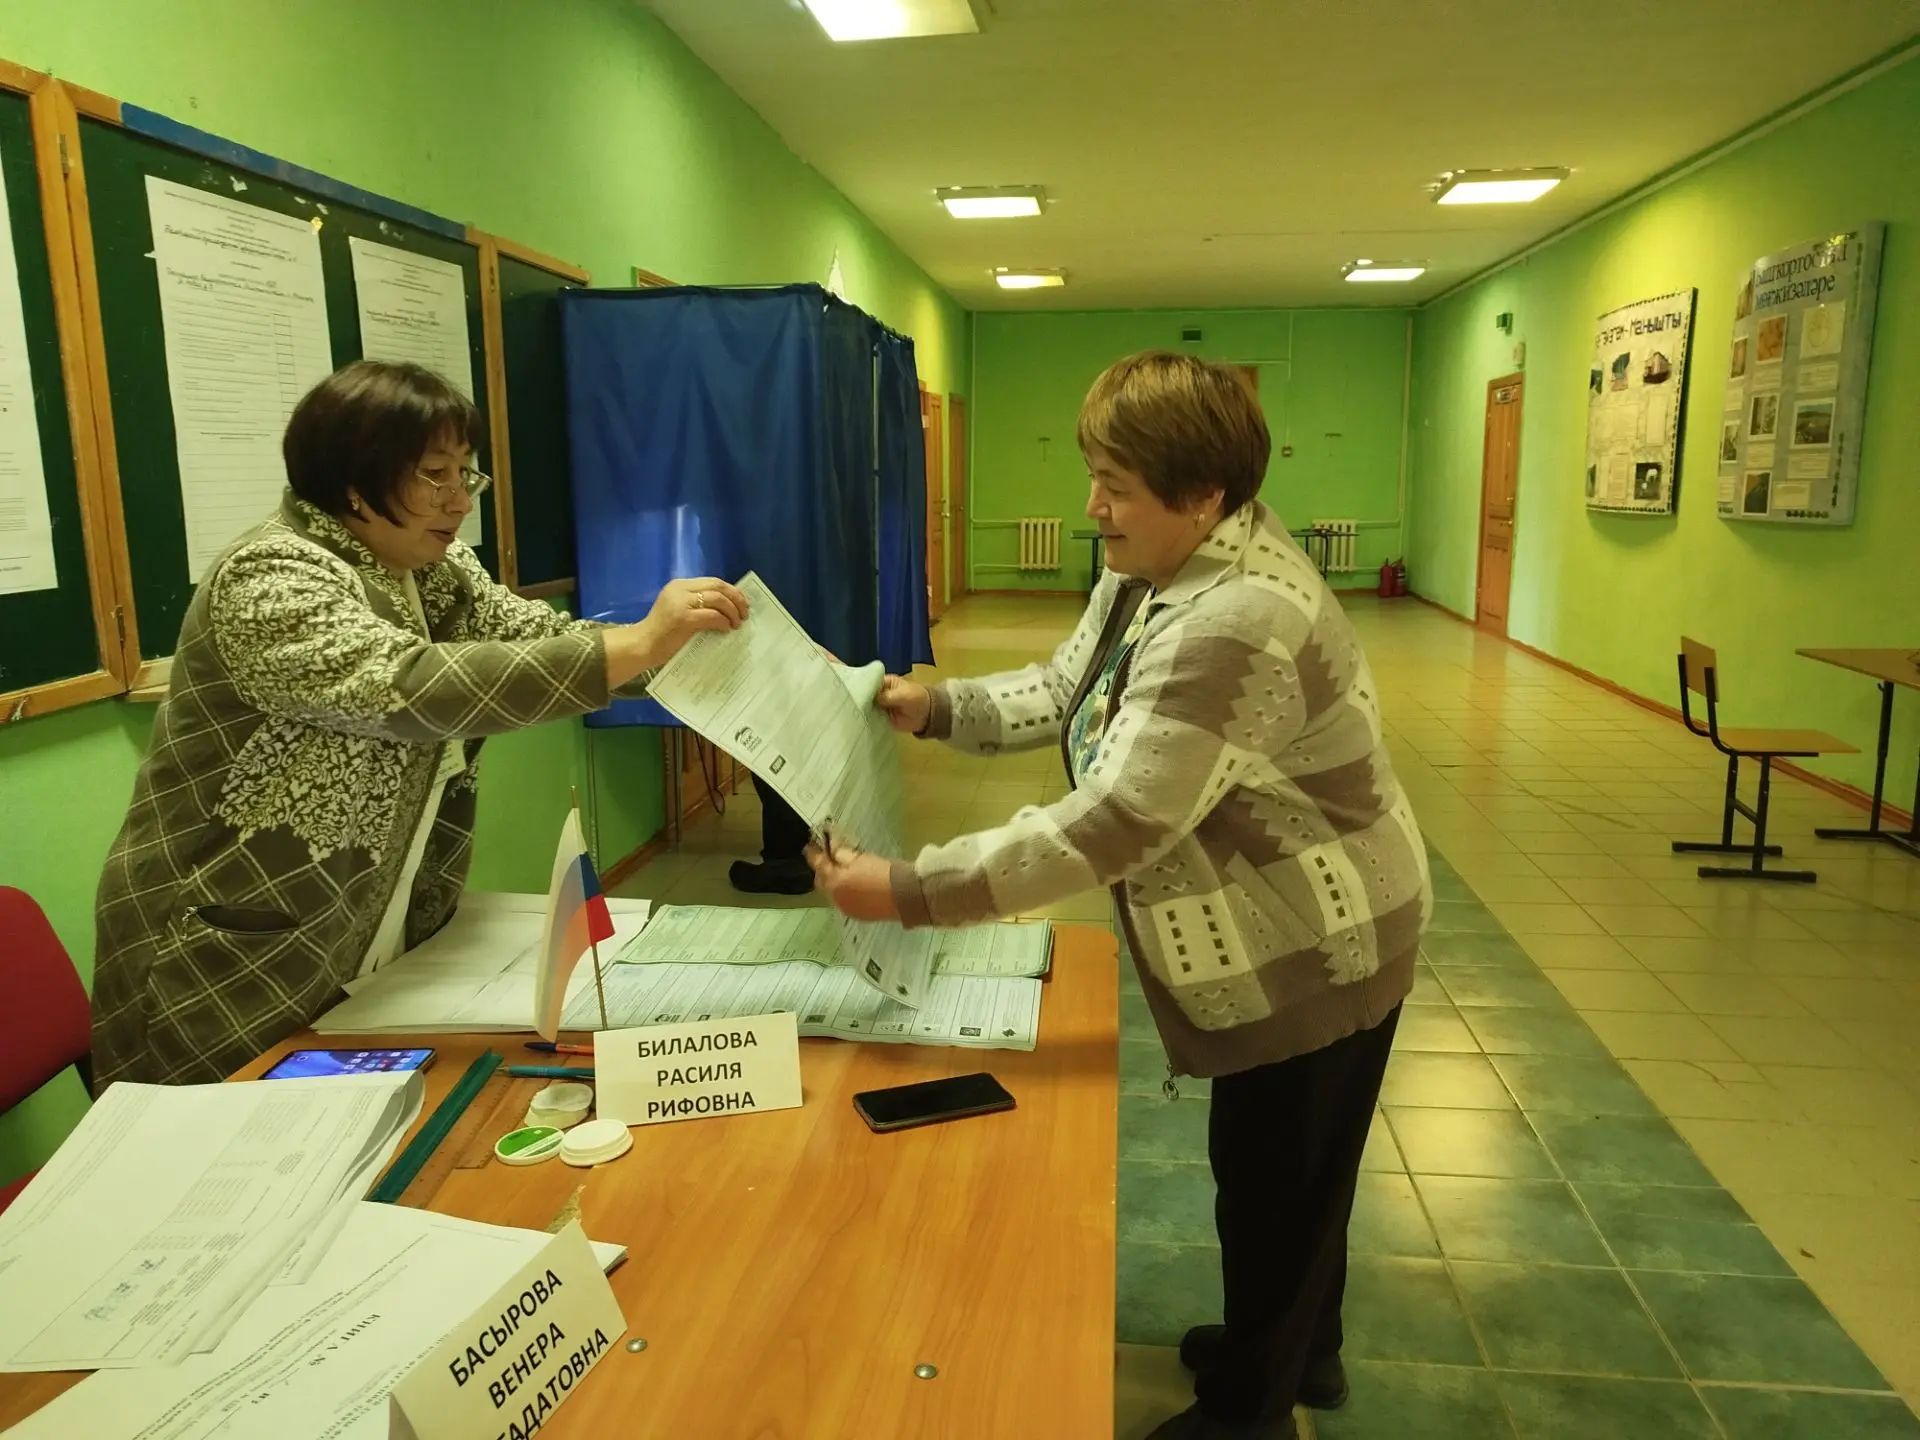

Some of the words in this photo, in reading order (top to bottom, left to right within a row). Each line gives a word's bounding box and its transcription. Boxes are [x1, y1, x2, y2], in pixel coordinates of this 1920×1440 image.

[638, 1030, 758, 1058] БИЛАЛОВА
[657, 1062, 742, 1087] РАСИЛЯ
[648, 1091, 756, 1119] РИФОВНА
[448, 1269, 563, 1387] БАСЫРОВА
[488, 1322, 566, 1409] ВЕНЕРА
